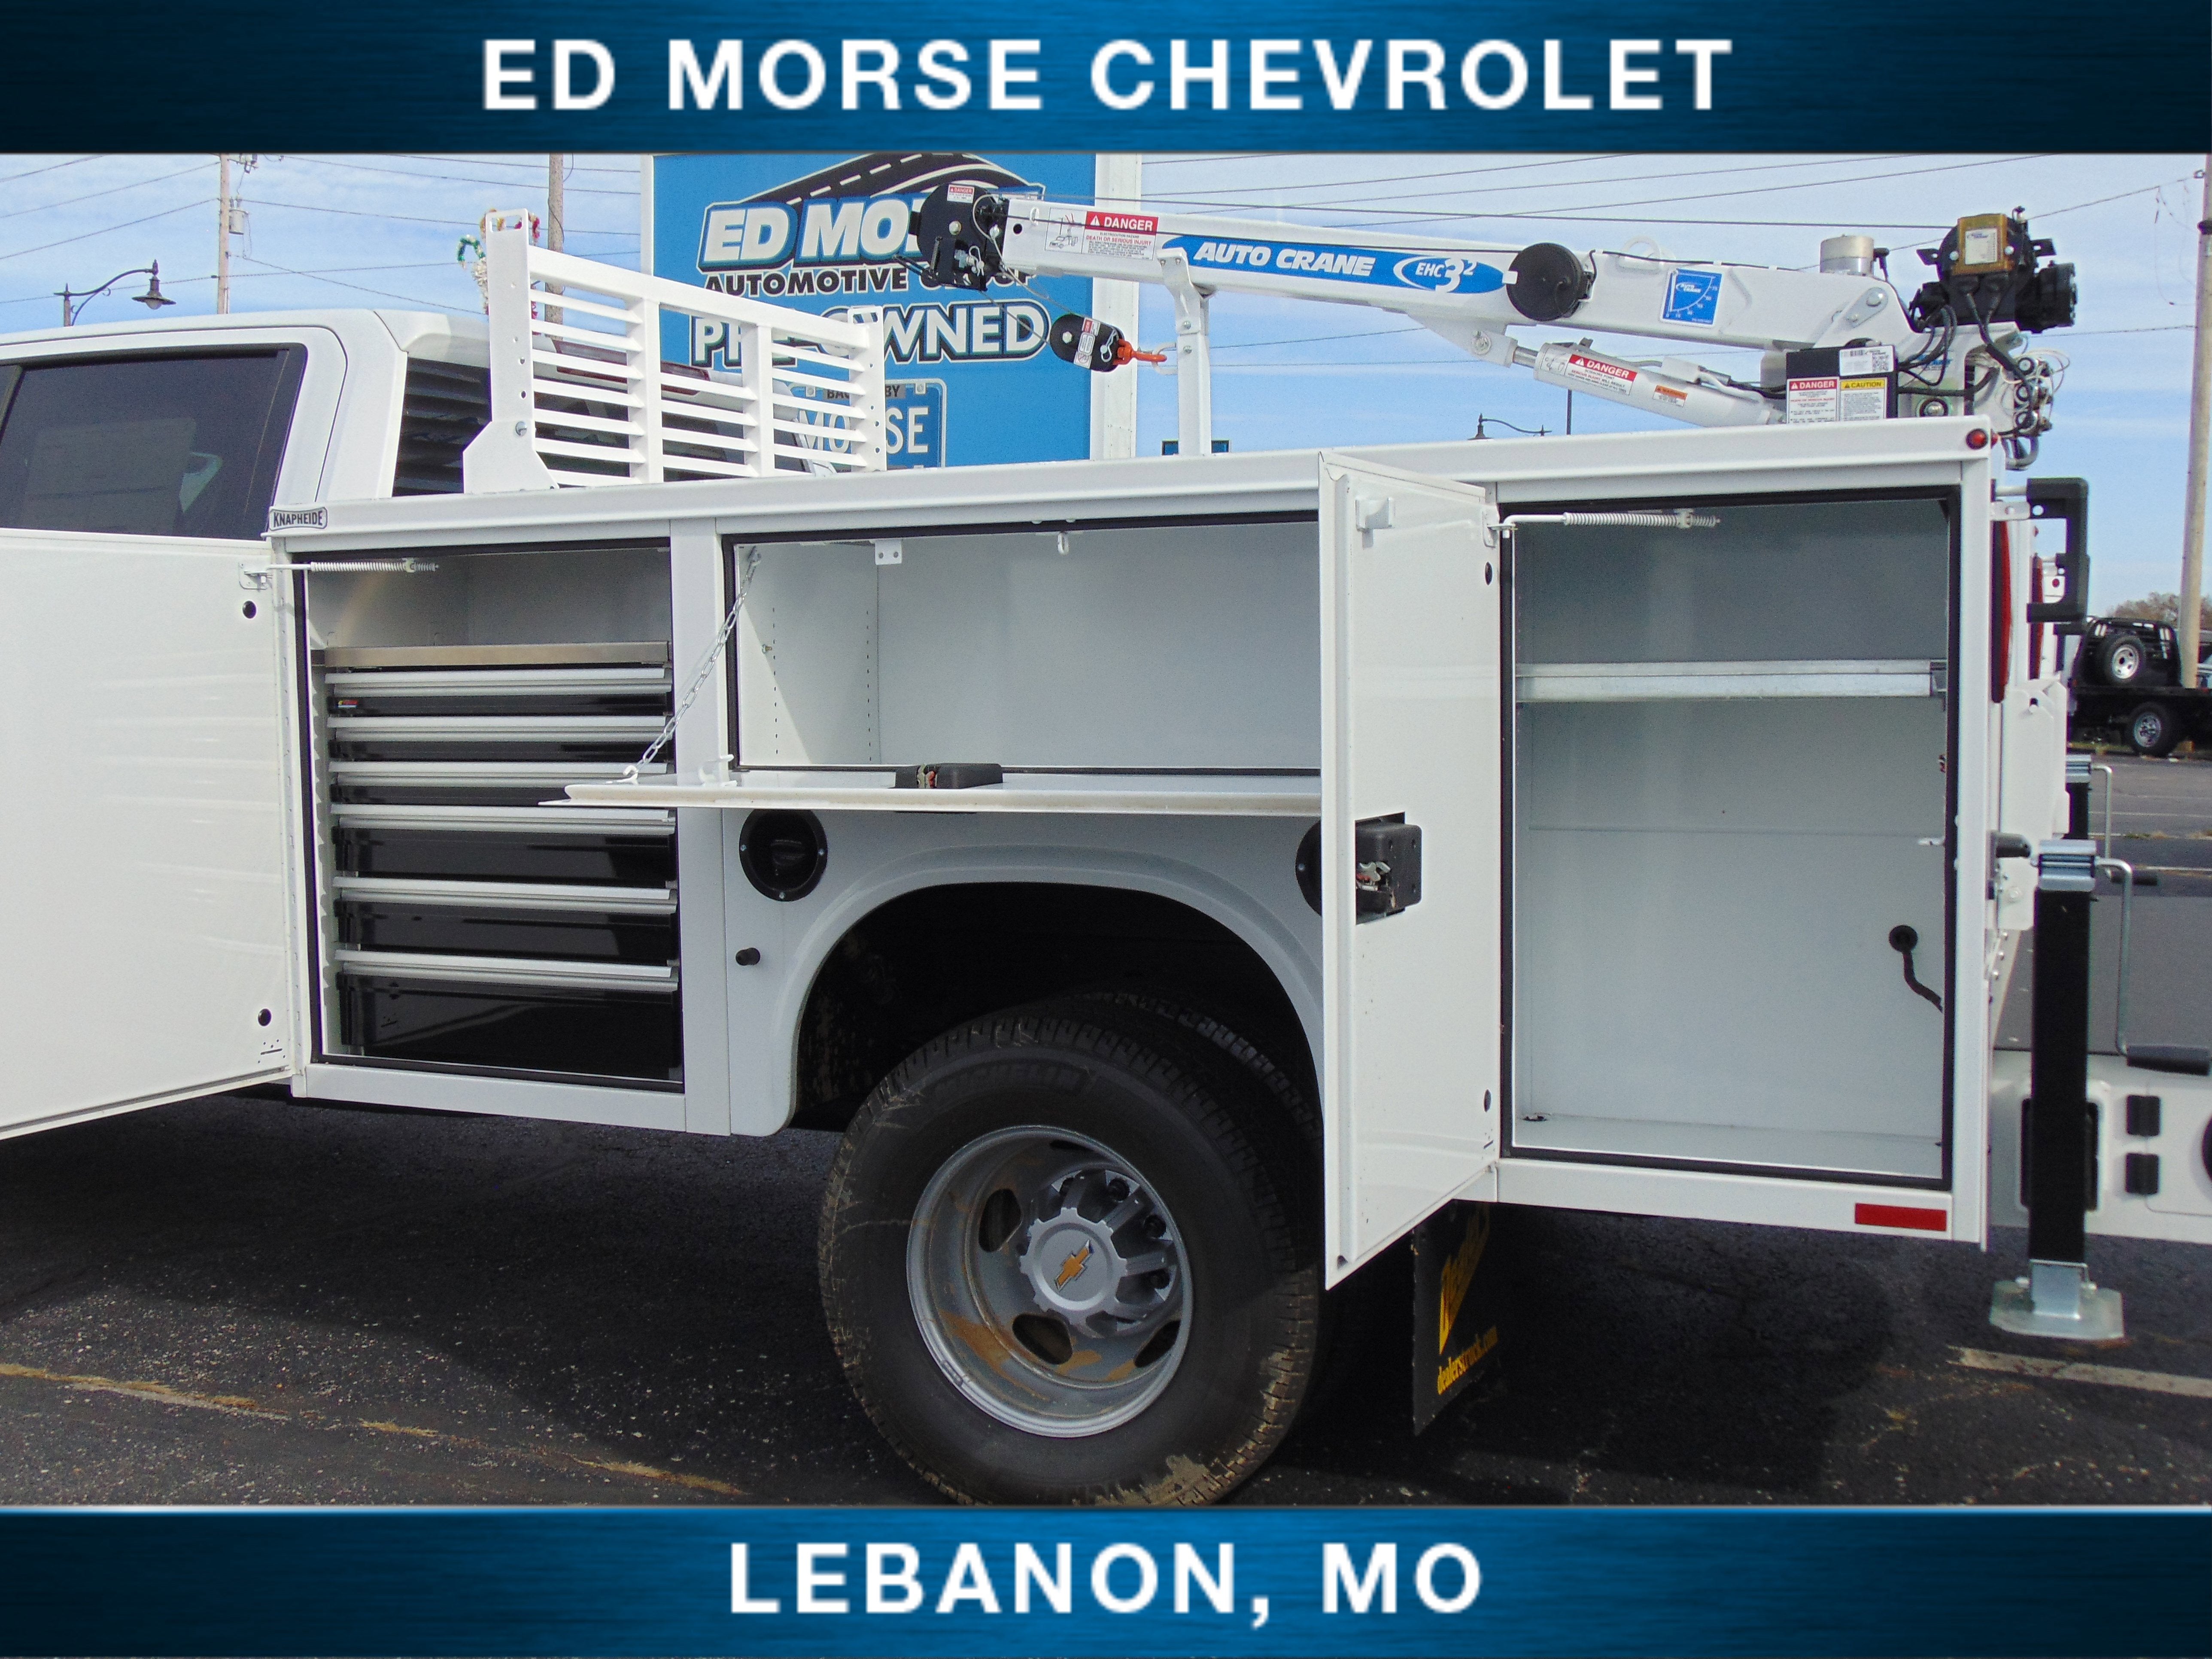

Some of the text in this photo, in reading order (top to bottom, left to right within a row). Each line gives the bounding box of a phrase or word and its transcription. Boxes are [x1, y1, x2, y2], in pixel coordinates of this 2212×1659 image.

[1104, 216, 1153, 231] DANGER
[704, 208, 789, 262] ED
[1193, 242, 1376, 276] AUTO CRANE
[1416, 262, 1446, 278] EHC
[705, 268, 908, 295] AUTOMOTIVE
[1586, 360, 1630, 379] DANGER
[1799, 380, 1835, 389] DANGER
[799, 407, 929, 454] MOSE
[273, 510, 323, 528] KNAPHEIDE
